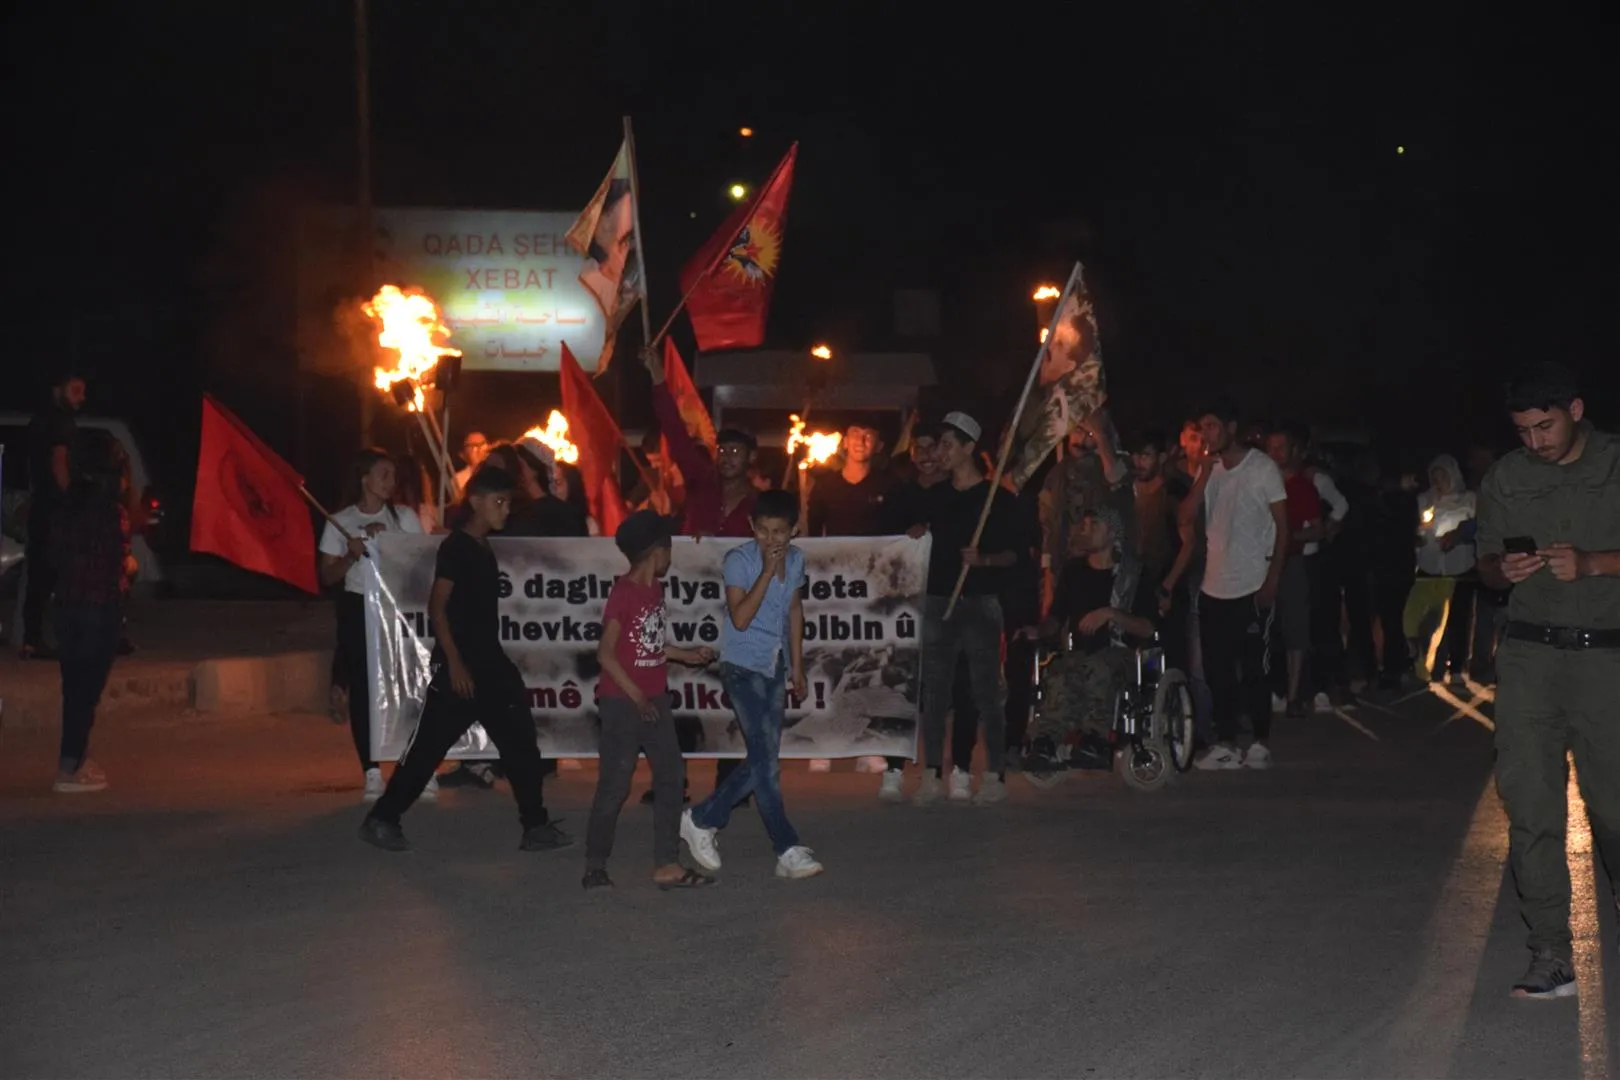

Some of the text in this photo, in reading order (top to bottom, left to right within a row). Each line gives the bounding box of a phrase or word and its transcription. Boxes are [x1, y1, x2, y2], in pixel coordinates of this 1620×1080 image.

[424, 233, 504, 255] QADA
[466, 268, 557, 290] XEBAT
[485, 339, 548, 364] خبات
[501, 616, 602, 641] hevka
[672, 614, 719, 642] wê
[895, 612, 915, 638] û
[529, 680, 582, 709] mê
